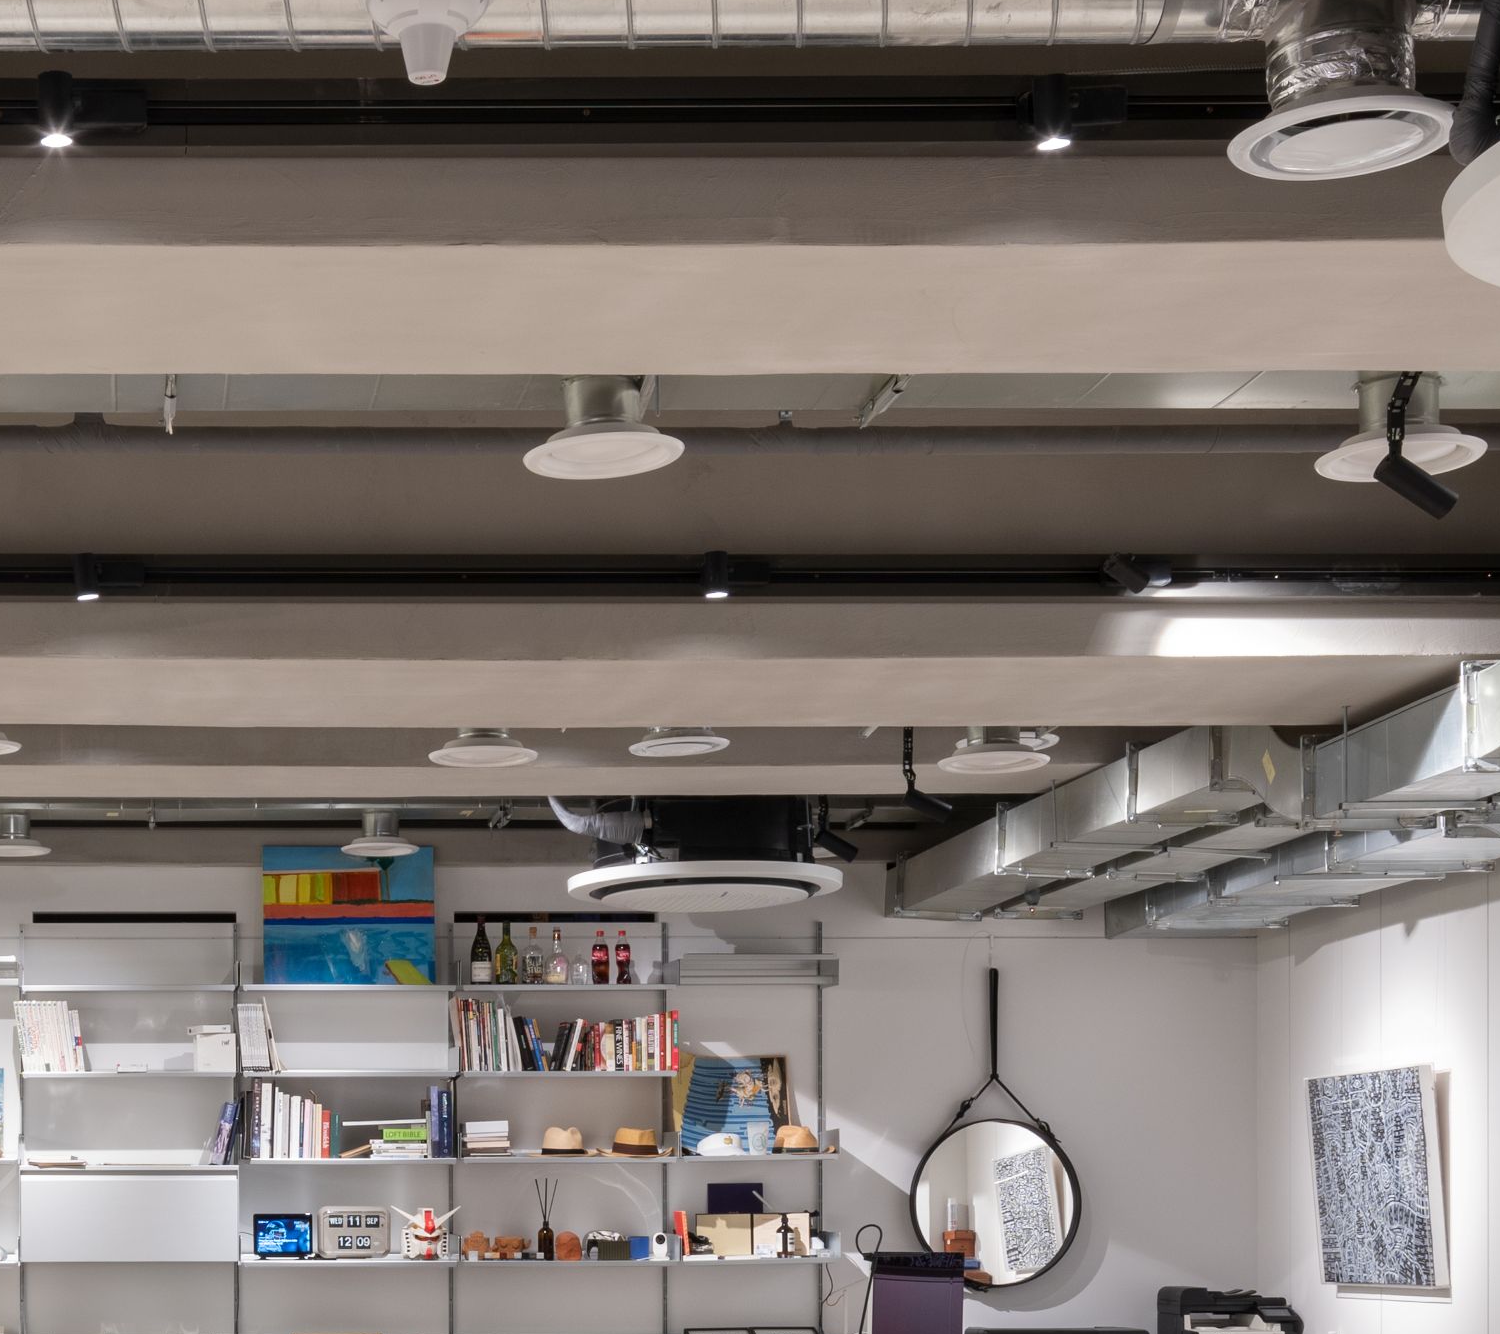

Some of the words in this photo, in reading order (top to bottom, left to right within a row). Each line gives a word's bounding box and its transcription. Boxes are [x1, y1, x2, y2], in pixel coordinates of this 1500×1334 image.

[615, 1026, 623, 1041] FINE
[615, 1042, 624, 1065] WINES
[329, 1217, 343, 1225] WED
[348, 1216, 360, 1226] 11
[366, 1217, 378, 1225] SEP
[338, 1237, 352, 1247] 12
[356, 1237, 370, 1247] 09
